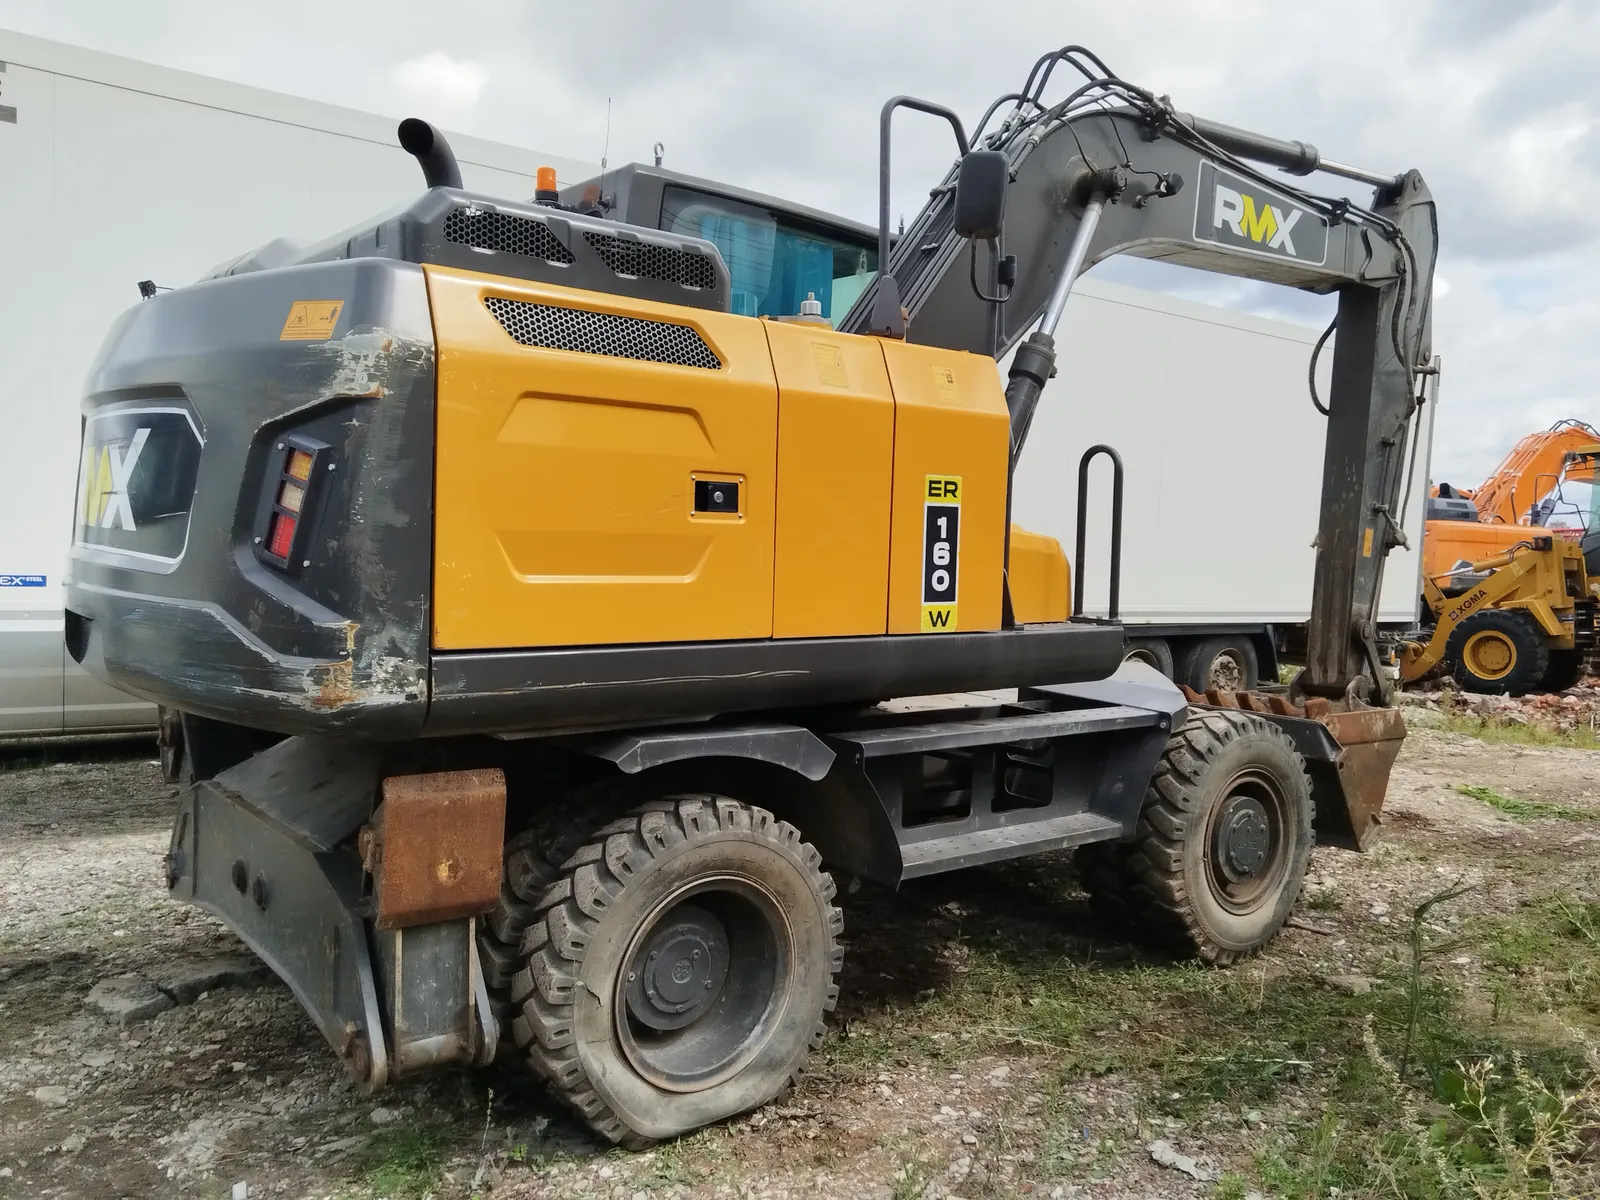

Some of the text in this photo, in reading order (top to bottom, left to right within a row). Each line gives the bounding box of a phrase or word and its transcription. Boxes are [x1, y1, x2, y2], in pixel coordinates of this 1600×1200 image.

[1213, 184, 1303, 256] RMX
[928, 480, 958, 498] ER
[931, 516, 951, 592] 160
[1457, 589, 1487, 614] XGMA
[928, 610, 951, 627] W
